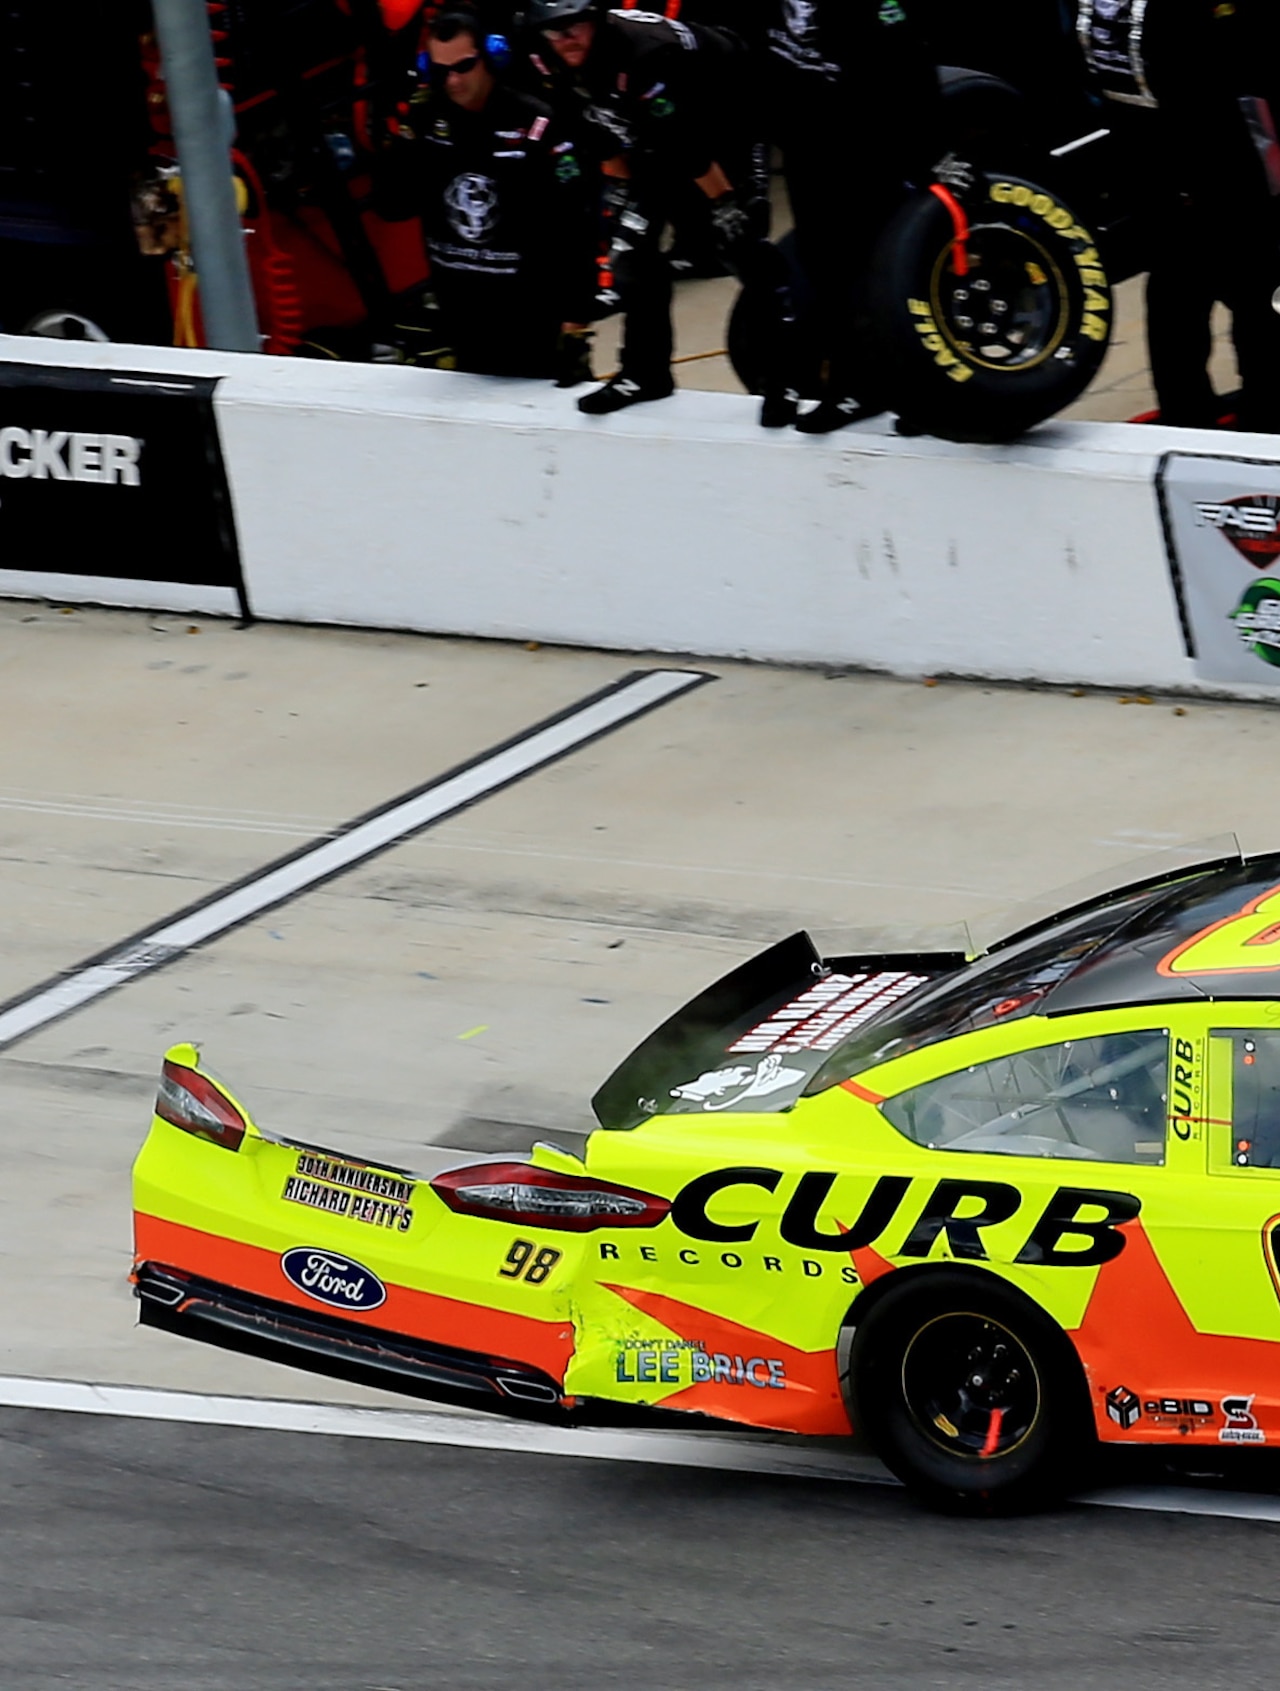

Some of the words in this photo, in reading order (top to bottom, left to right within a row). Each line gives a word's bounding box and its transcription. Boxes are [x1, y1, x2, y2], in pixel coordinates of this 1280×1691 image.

[990, 182, 1109, 341] GOODYEAR
[906, 298, 974, 382] EAGLE
[769, 973, 870, 1019] 200TH
[727, 1020, 801, 1052] WIN
[1173, 1037, 1194, 1141] CURB
[297, 1154, 331, 1180] 30TH
[329, 1163, 415, 1204] ANNIVERSARY
[283, 1176, 351, 1215] RICHARD
[350, 1196, 413, 1232] PETTY'S
[670, 1166, 1142, 1267] CURB
[301, 1254, 365, 1301] Ford
[501, 1240, 561, 1283] 98
[600, 1243, 859, 1284] RECORDS
[616, 1350, 680, 1383] LEE
[691, 1350, 787, 1389] BRICE
[1145, 1398, 1214, 1416] eBID
